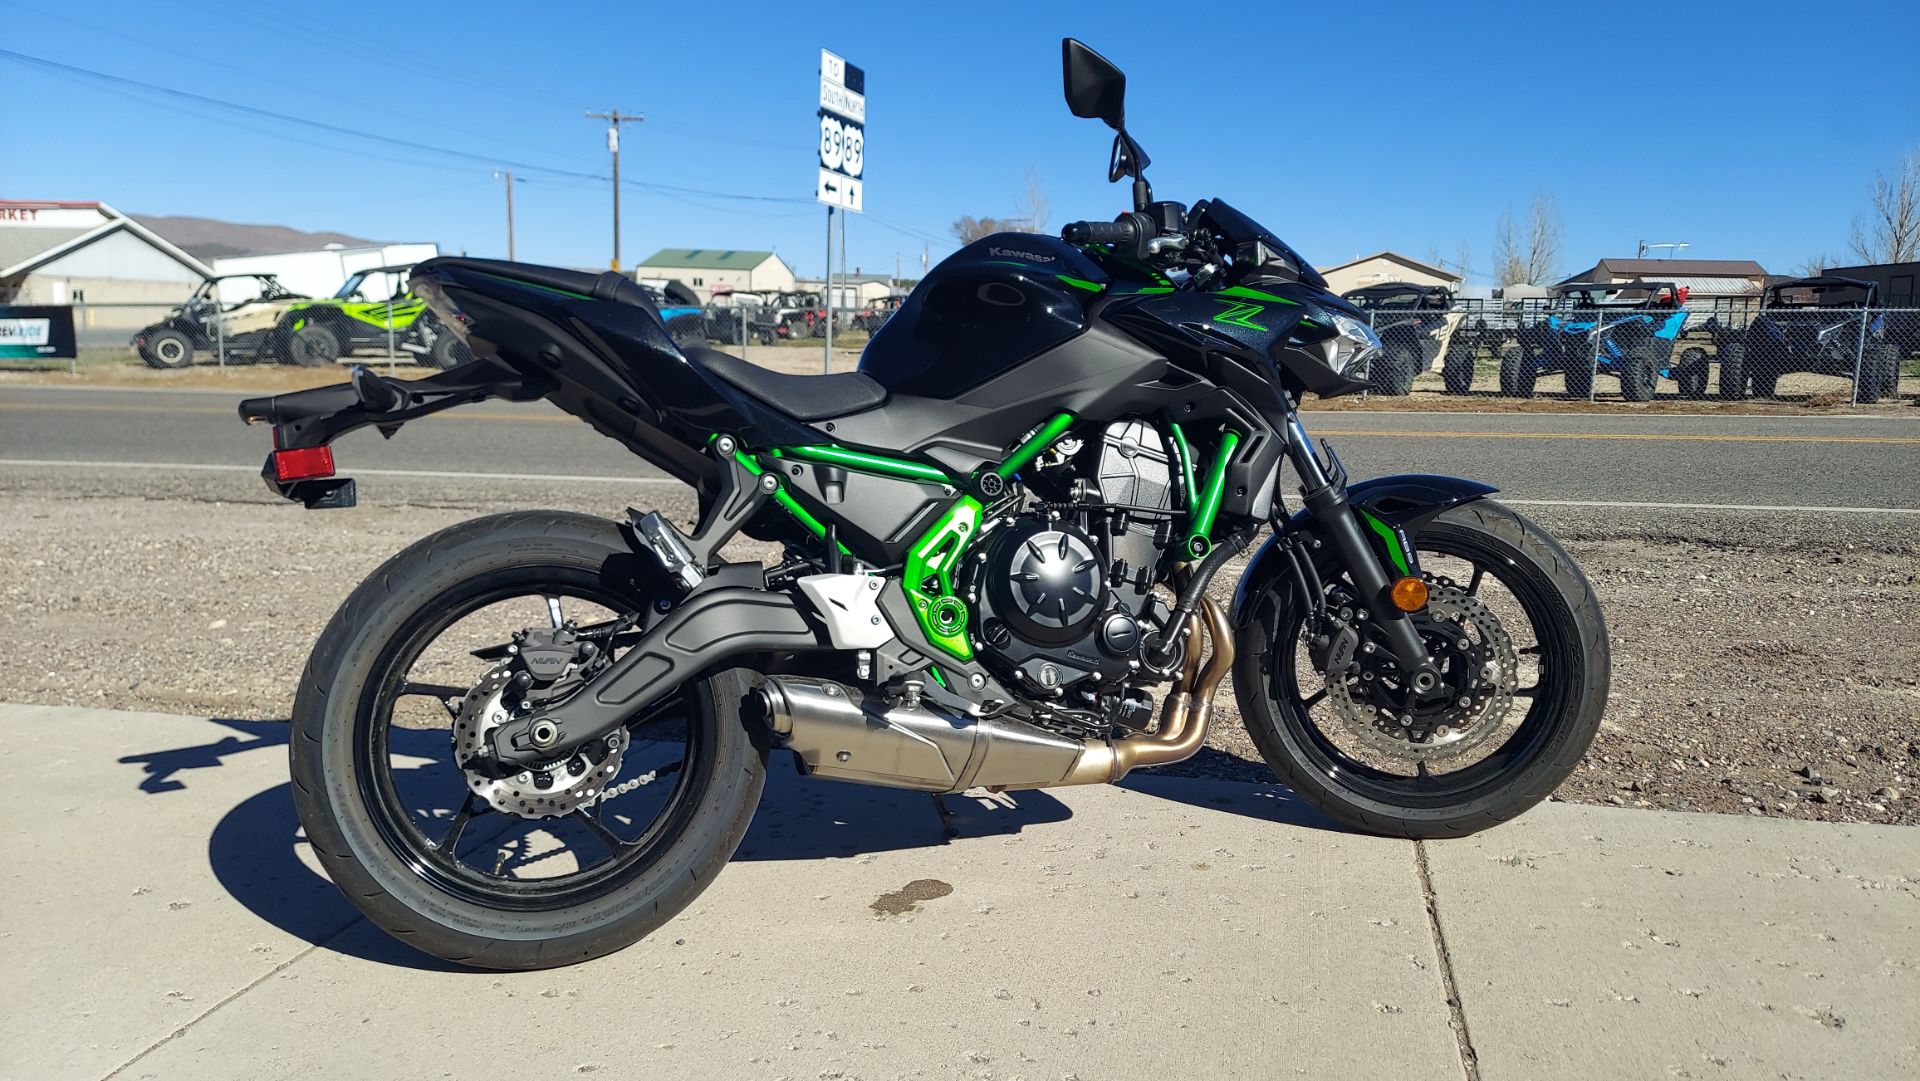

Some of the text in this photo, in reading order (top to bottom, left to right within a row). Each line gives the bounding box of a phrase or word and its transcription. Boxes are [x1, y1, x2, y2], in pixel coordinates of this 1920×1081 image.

[828, 59, 840, 77] TO
[823, 84, 843, 108] SOUTH
[845, 96, 864, 116] NORTH
[823, 127, 842, 157] 89
[845, 136, 862, 163] 89
